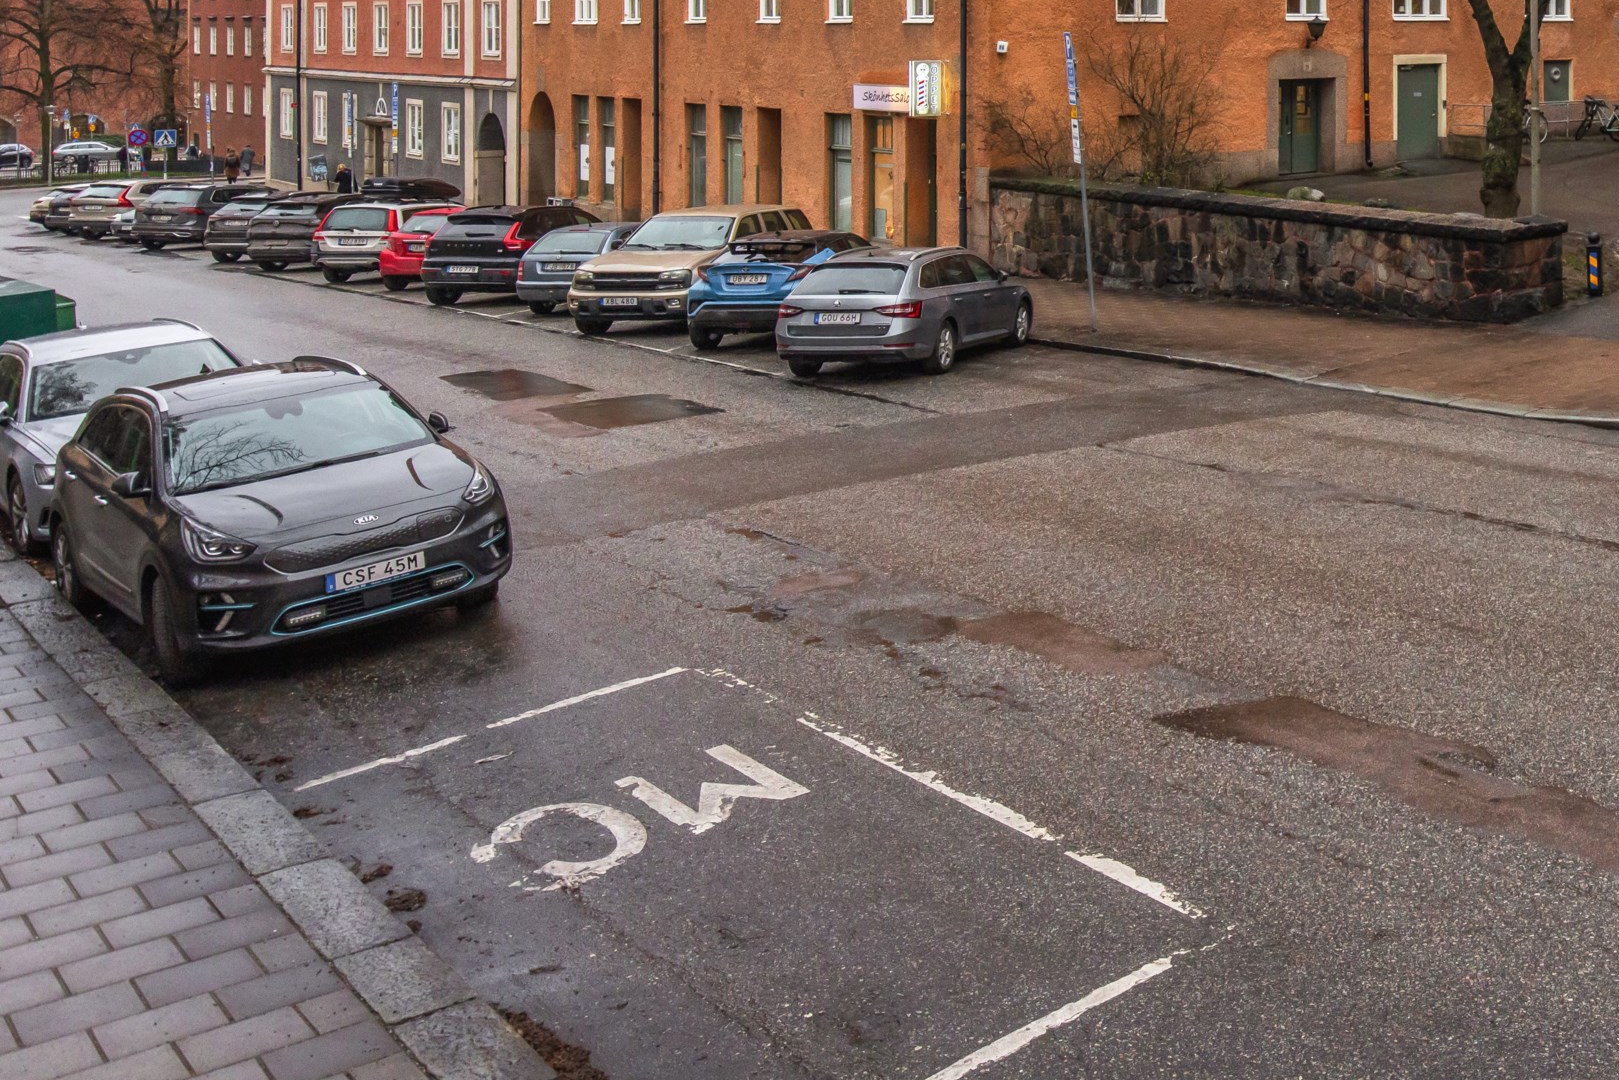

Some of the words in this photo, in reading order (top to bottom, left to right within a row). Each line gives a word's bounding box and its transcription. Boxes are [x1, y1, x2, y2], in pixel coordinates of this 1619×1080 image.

[840, 313, 857, 321] 66H
[358, 515, 375, 523] KIA
[343, 565, 376, 586] CSF
[384, 554, 419, 575] 45M
[470, 744, 811, 892] MC
